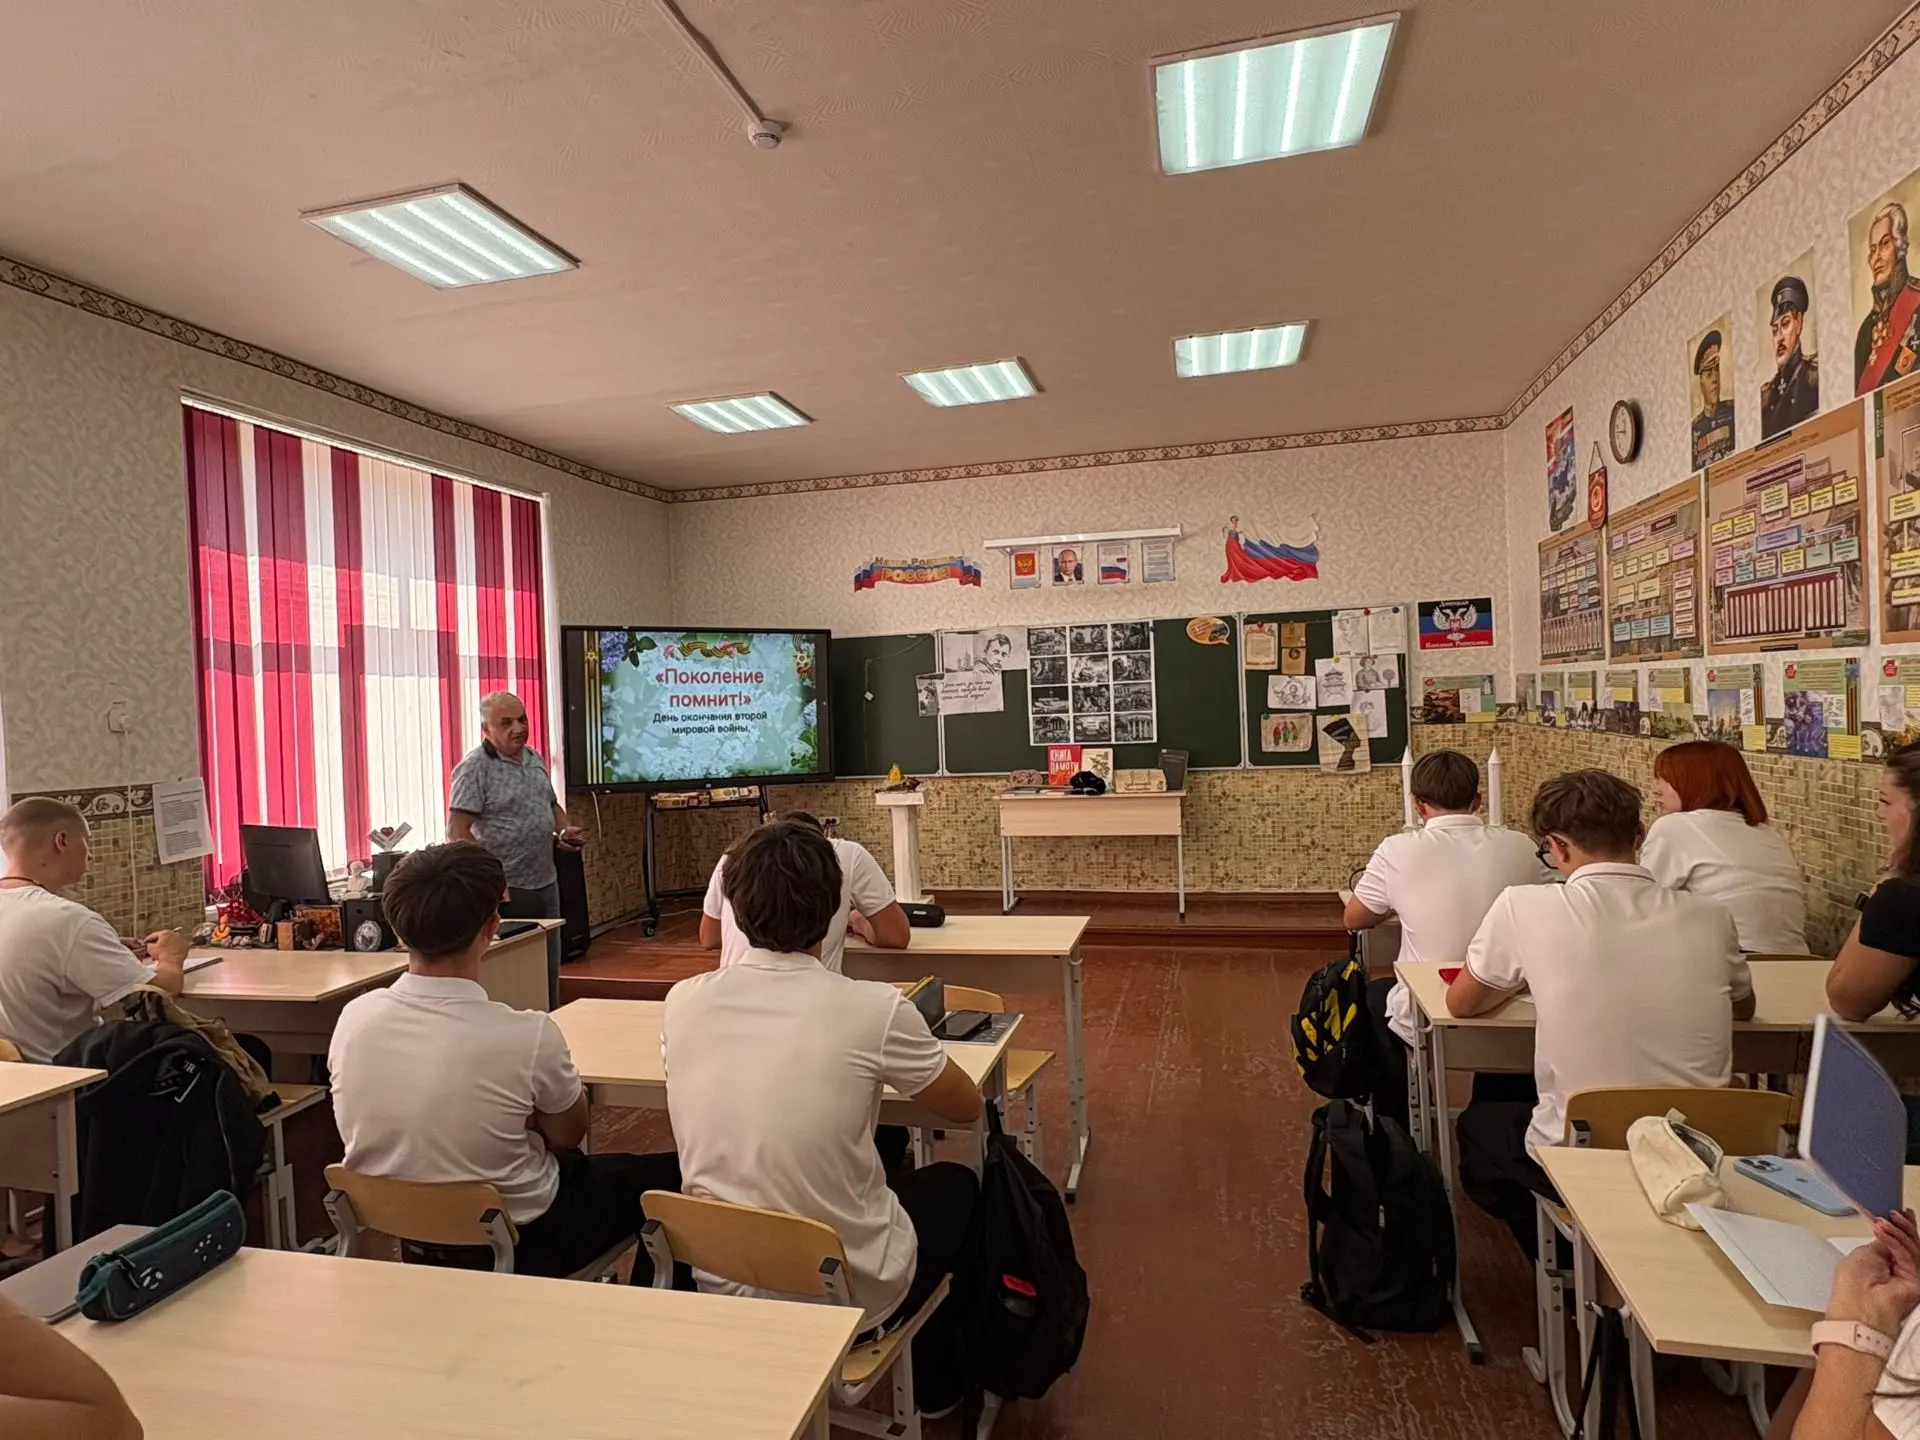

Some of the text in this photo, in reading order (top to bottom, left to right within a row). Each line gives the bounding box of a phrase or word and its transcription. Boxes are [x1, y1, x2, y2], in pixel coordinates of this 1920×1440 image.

[655, 668, 764, 685] «Поколение
[669, 691, 752, 707] помнит!»
[653, 711, 767, 723] День окончания второй
[672, 724, 715, 735] мировой
[1050, 749, 1072, 761] КНИГА
